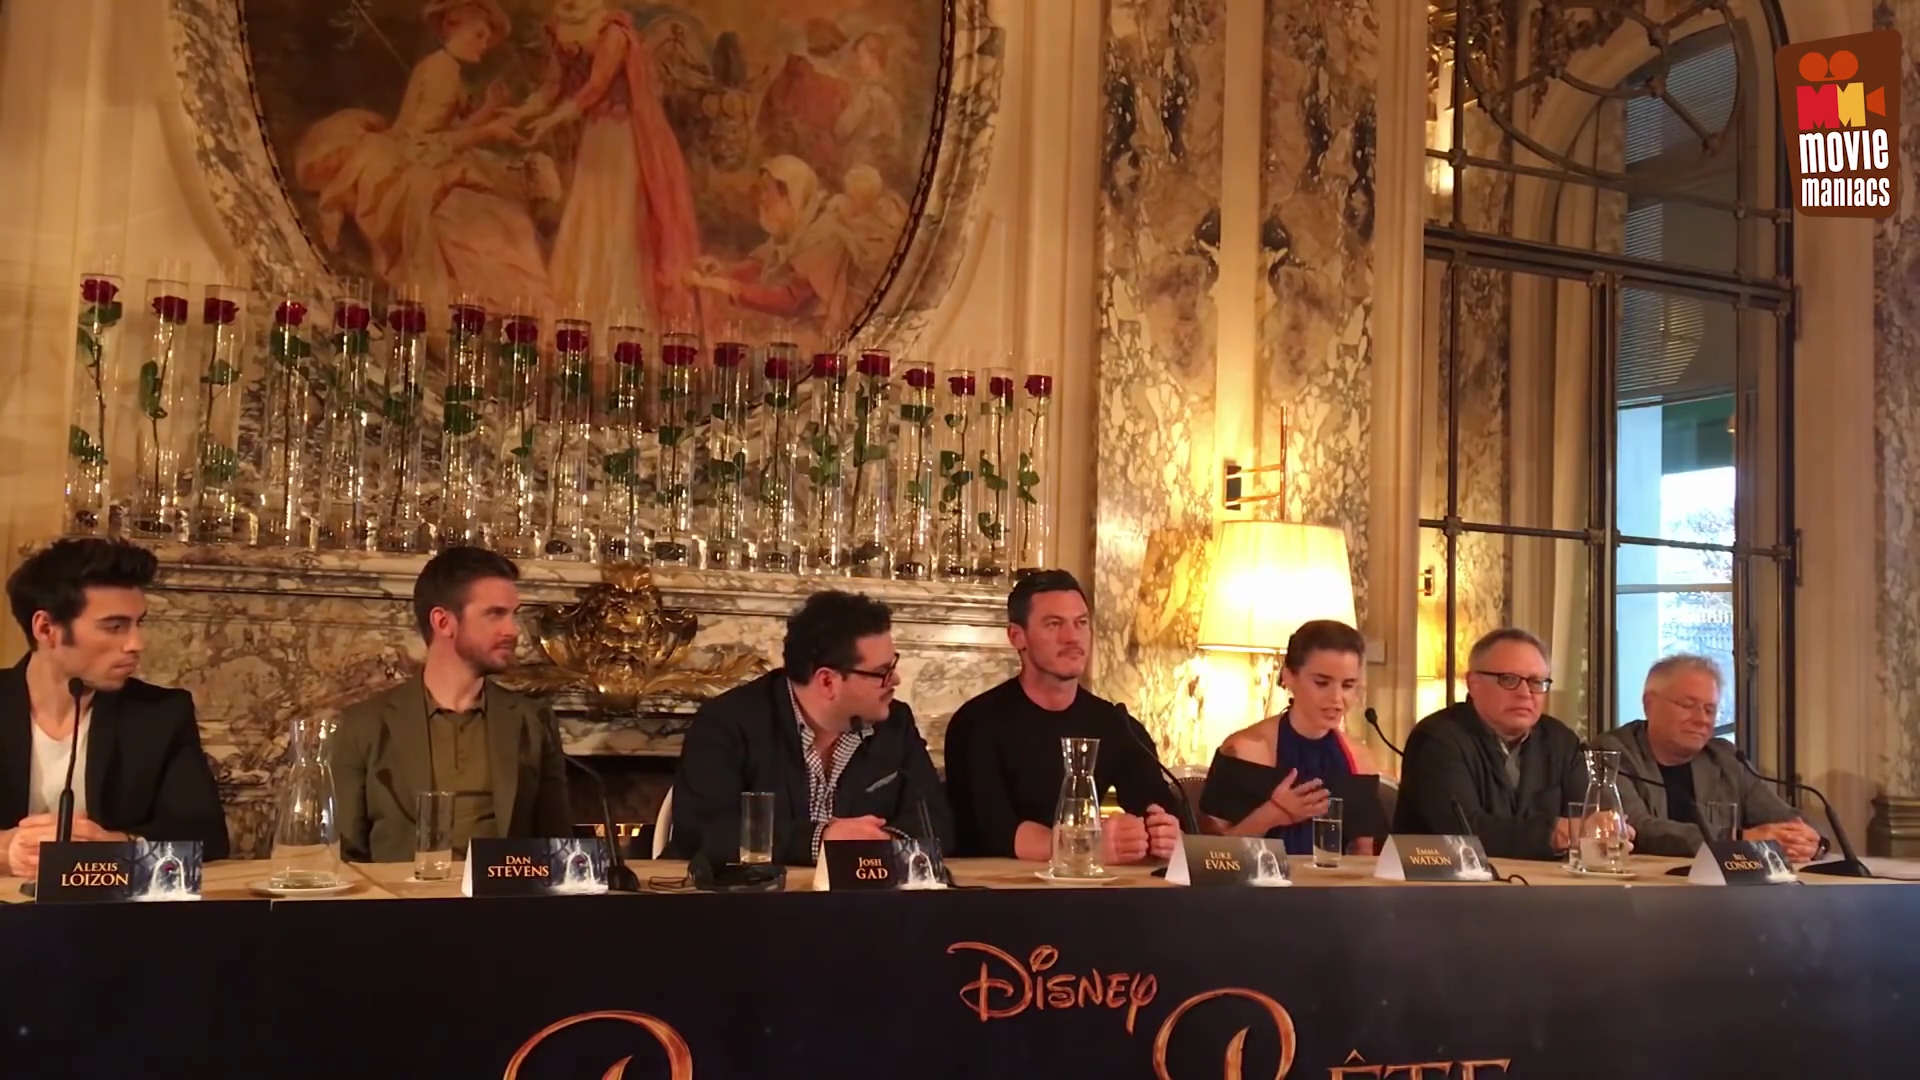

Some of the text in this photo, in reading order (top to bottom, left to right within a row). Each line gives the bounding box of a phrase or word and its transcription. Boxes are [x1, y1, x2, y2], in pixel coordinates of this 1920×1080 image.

[1209, 850, 1233, 860] LUKE
[1415, 847, 1440, 855] EMMA
[505, 855, 532, 865] DAN
[858, 857, 883, 868] JOSH
[1204, 859, 1241, 871] EVANS
[1408, 855, 1453, 866] WATSON
[72, 861, 119, 872] ALEXIS
[487, 865, 550, 878] STEVENS
[1723, 861, 1764, 871] CONDON
[855, 868, 889, 880] GAD
[61, 873, 129, 887] LOIZON
